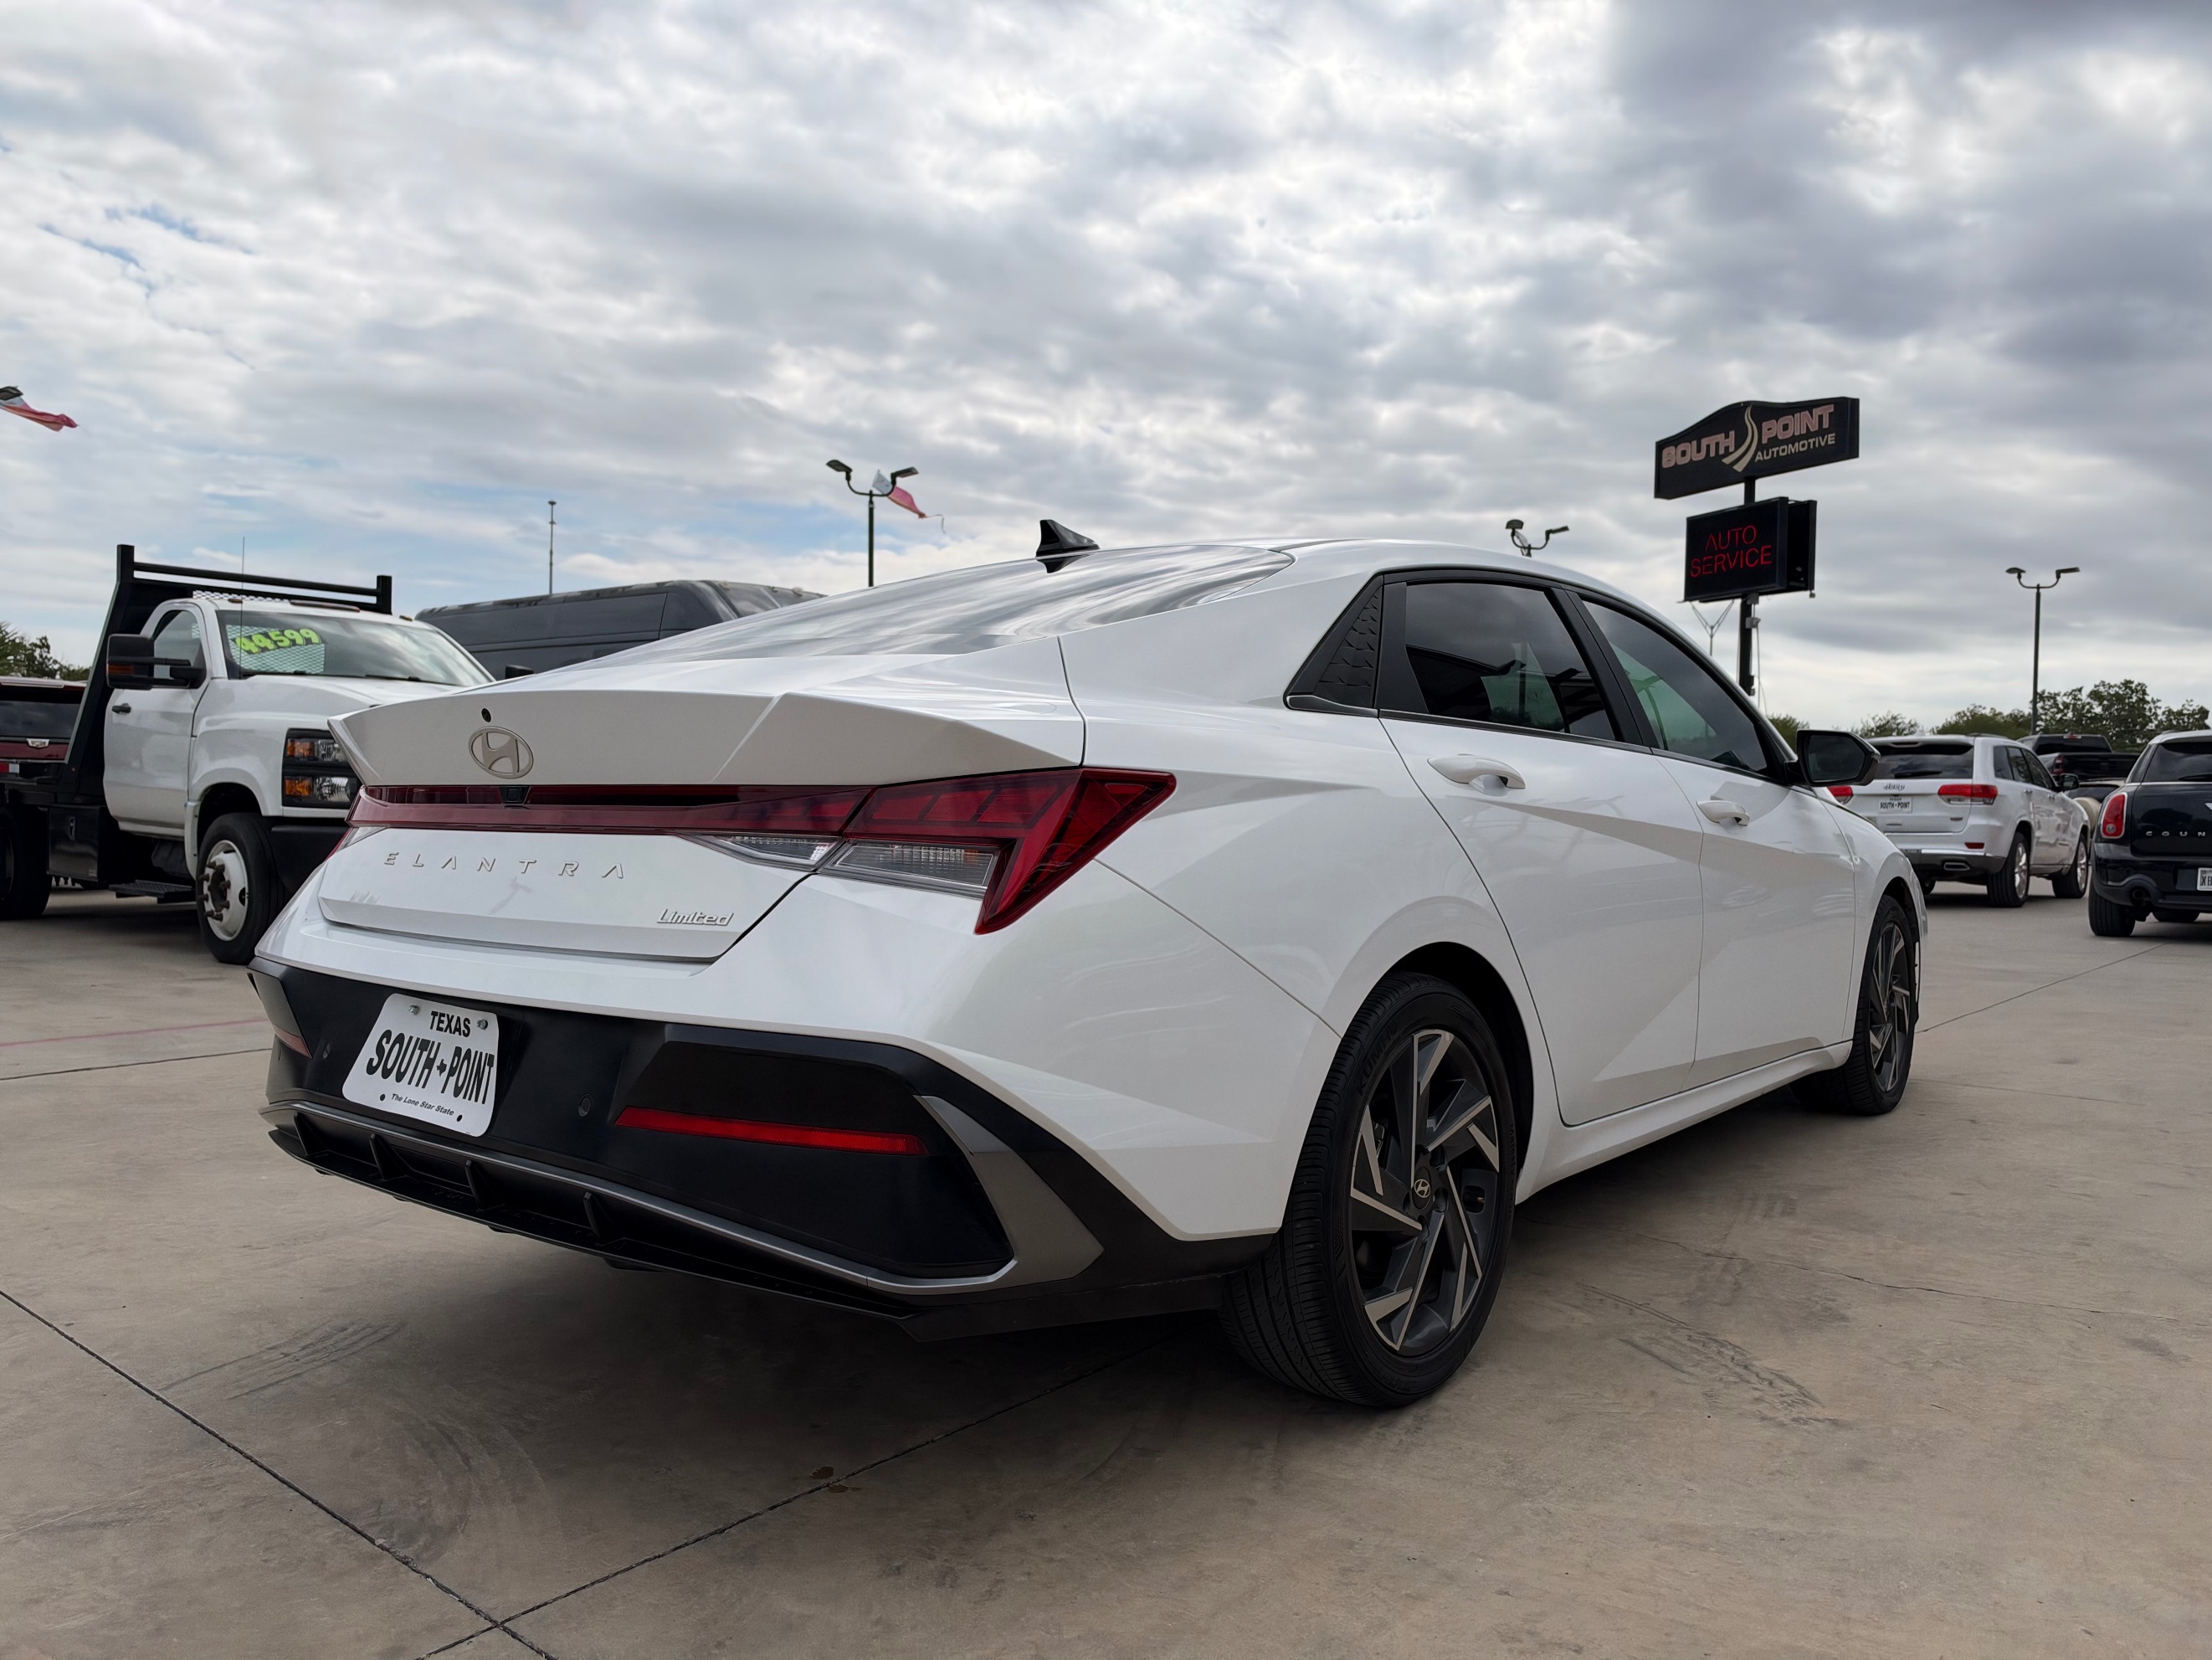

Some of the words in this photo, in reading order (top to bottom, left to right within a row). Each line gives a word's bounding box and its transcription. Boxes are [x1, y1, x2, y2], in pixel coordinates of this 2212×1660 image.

[1662, 430, 1735, 468] SOUTH
[1762, 404, 1835, 445] POINT
[1754, 433, 1835, 462] AUTOMOTIVE
[1706, 525, 1757, 552] AUTO
[1691, 545, 1773, 578] SERVICE
[235, 628, 321, 654] 44599
[383, 851, 624, 879] ELANTRA
[657, 908, 735, 927] Limited
[429, 1010, 471, 1037] TEXAS
[366, 1029, 441, 1089] SOUTH
[440, 1046, 495, 1105] POINT
[391, 1092, 403, 1102] The
[403, 1097, 419, 1106] Lone
[419, 1101, 435, 1110] Star
[434, 1105, 454, 1116] State
